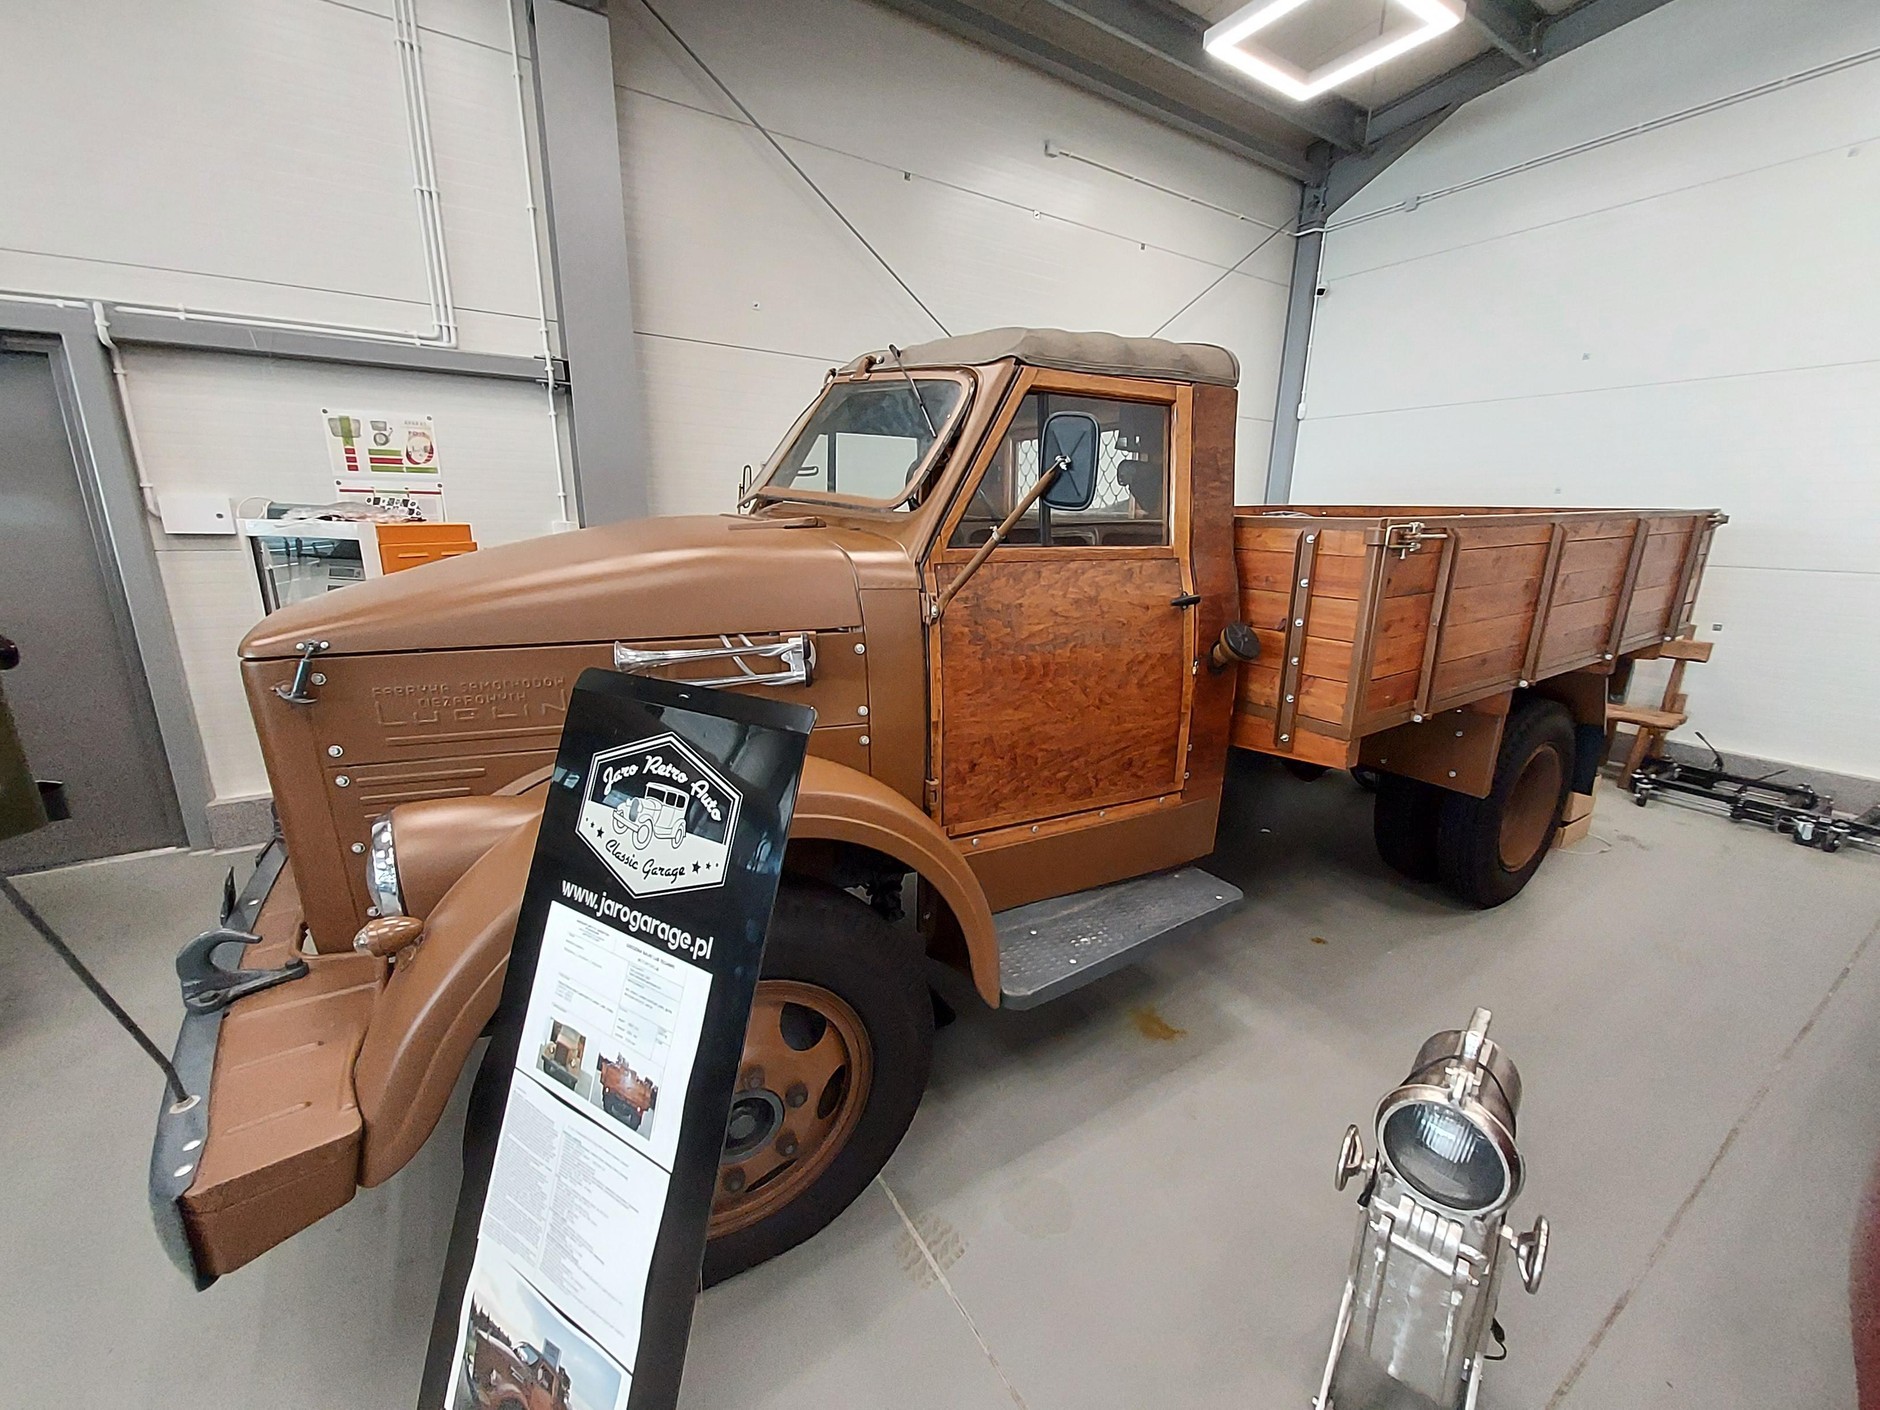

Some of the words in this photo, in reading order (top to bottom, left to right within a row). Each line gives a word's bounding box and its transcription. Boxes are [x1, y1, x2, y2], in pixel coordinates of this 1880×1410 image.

[603, 764, 638, 795] Jaro
[642, 755, 688, 784] Retro
[691, 779, 722, 822] Auto
[605, 839, 639, 870] Classic
[642, 858, 686, 884] Garage
[562, 880, 714, 960] www.jarogarage.pl
